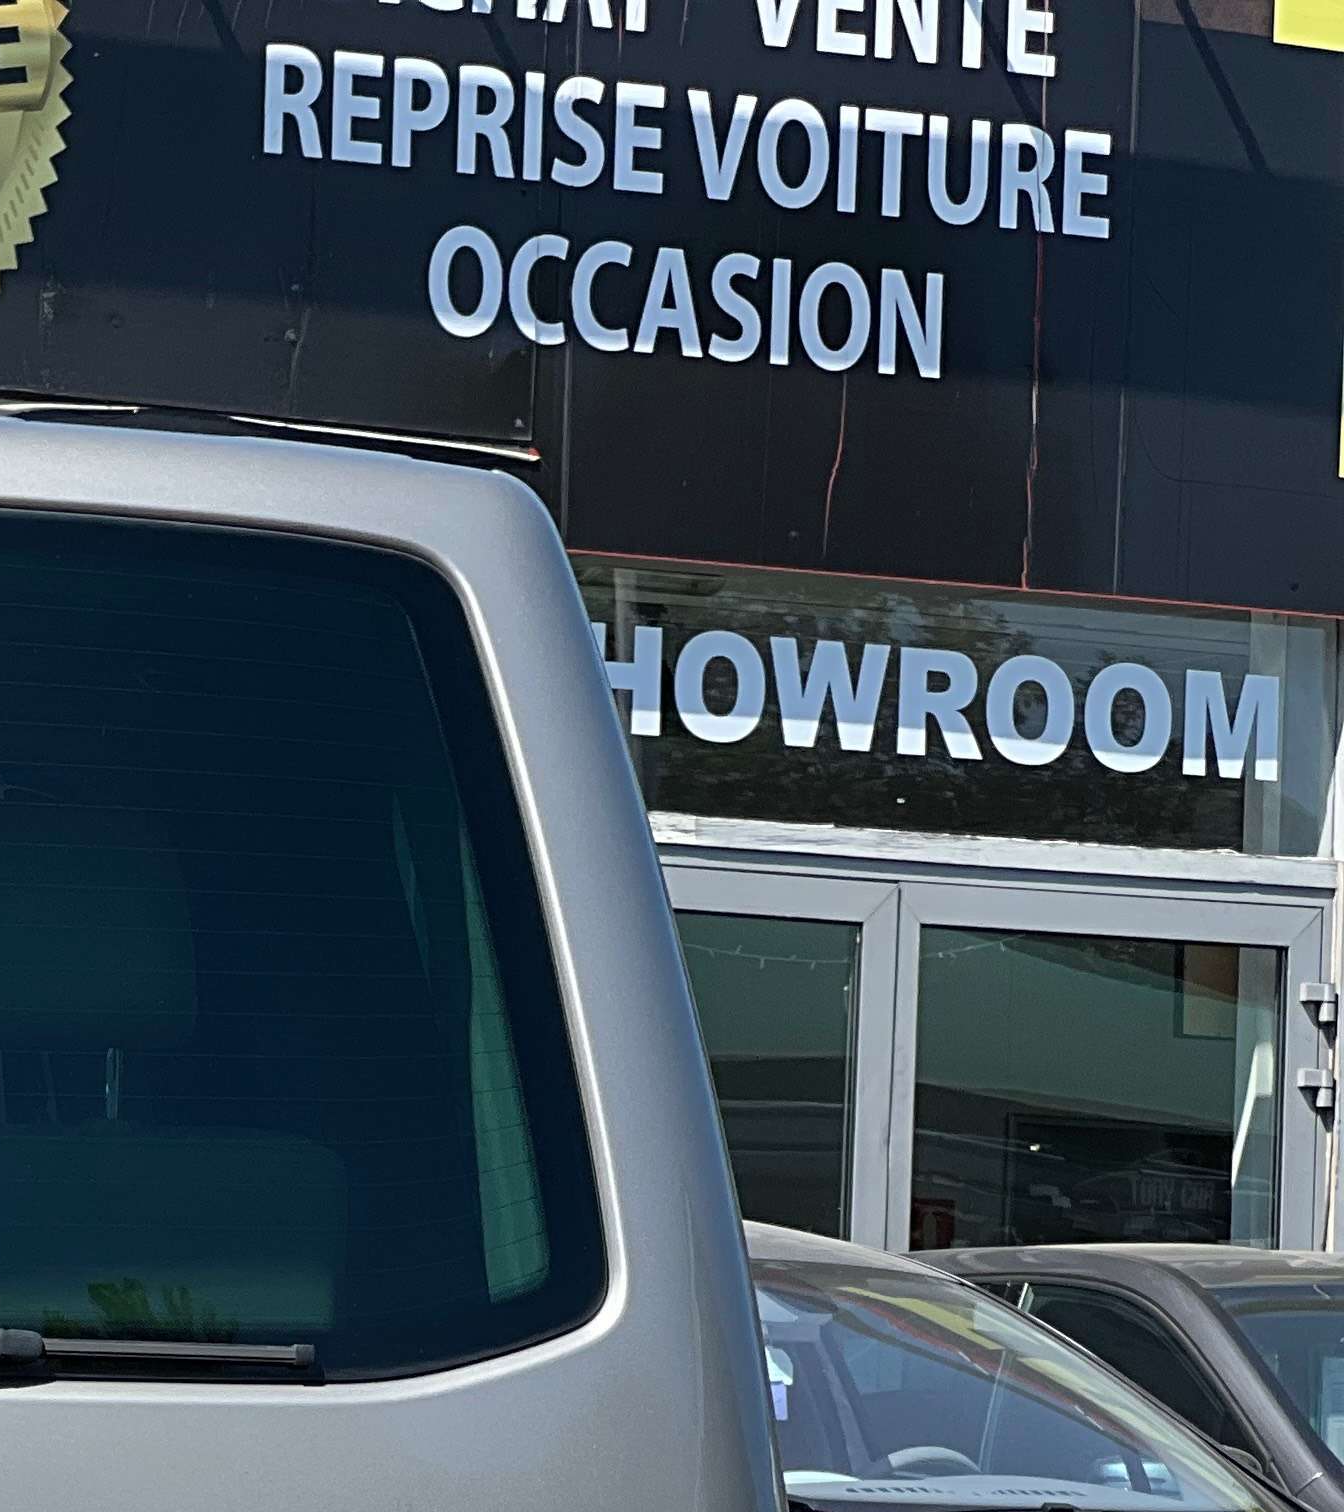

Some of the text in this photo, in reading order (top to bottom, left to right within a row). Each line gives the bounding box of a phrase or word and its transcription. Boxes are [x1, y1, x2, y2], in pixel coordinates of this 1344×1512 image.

[262, 44, 1112, 239] REPRISE VOITURE
[428, 225, 944, 380] OCCASION
